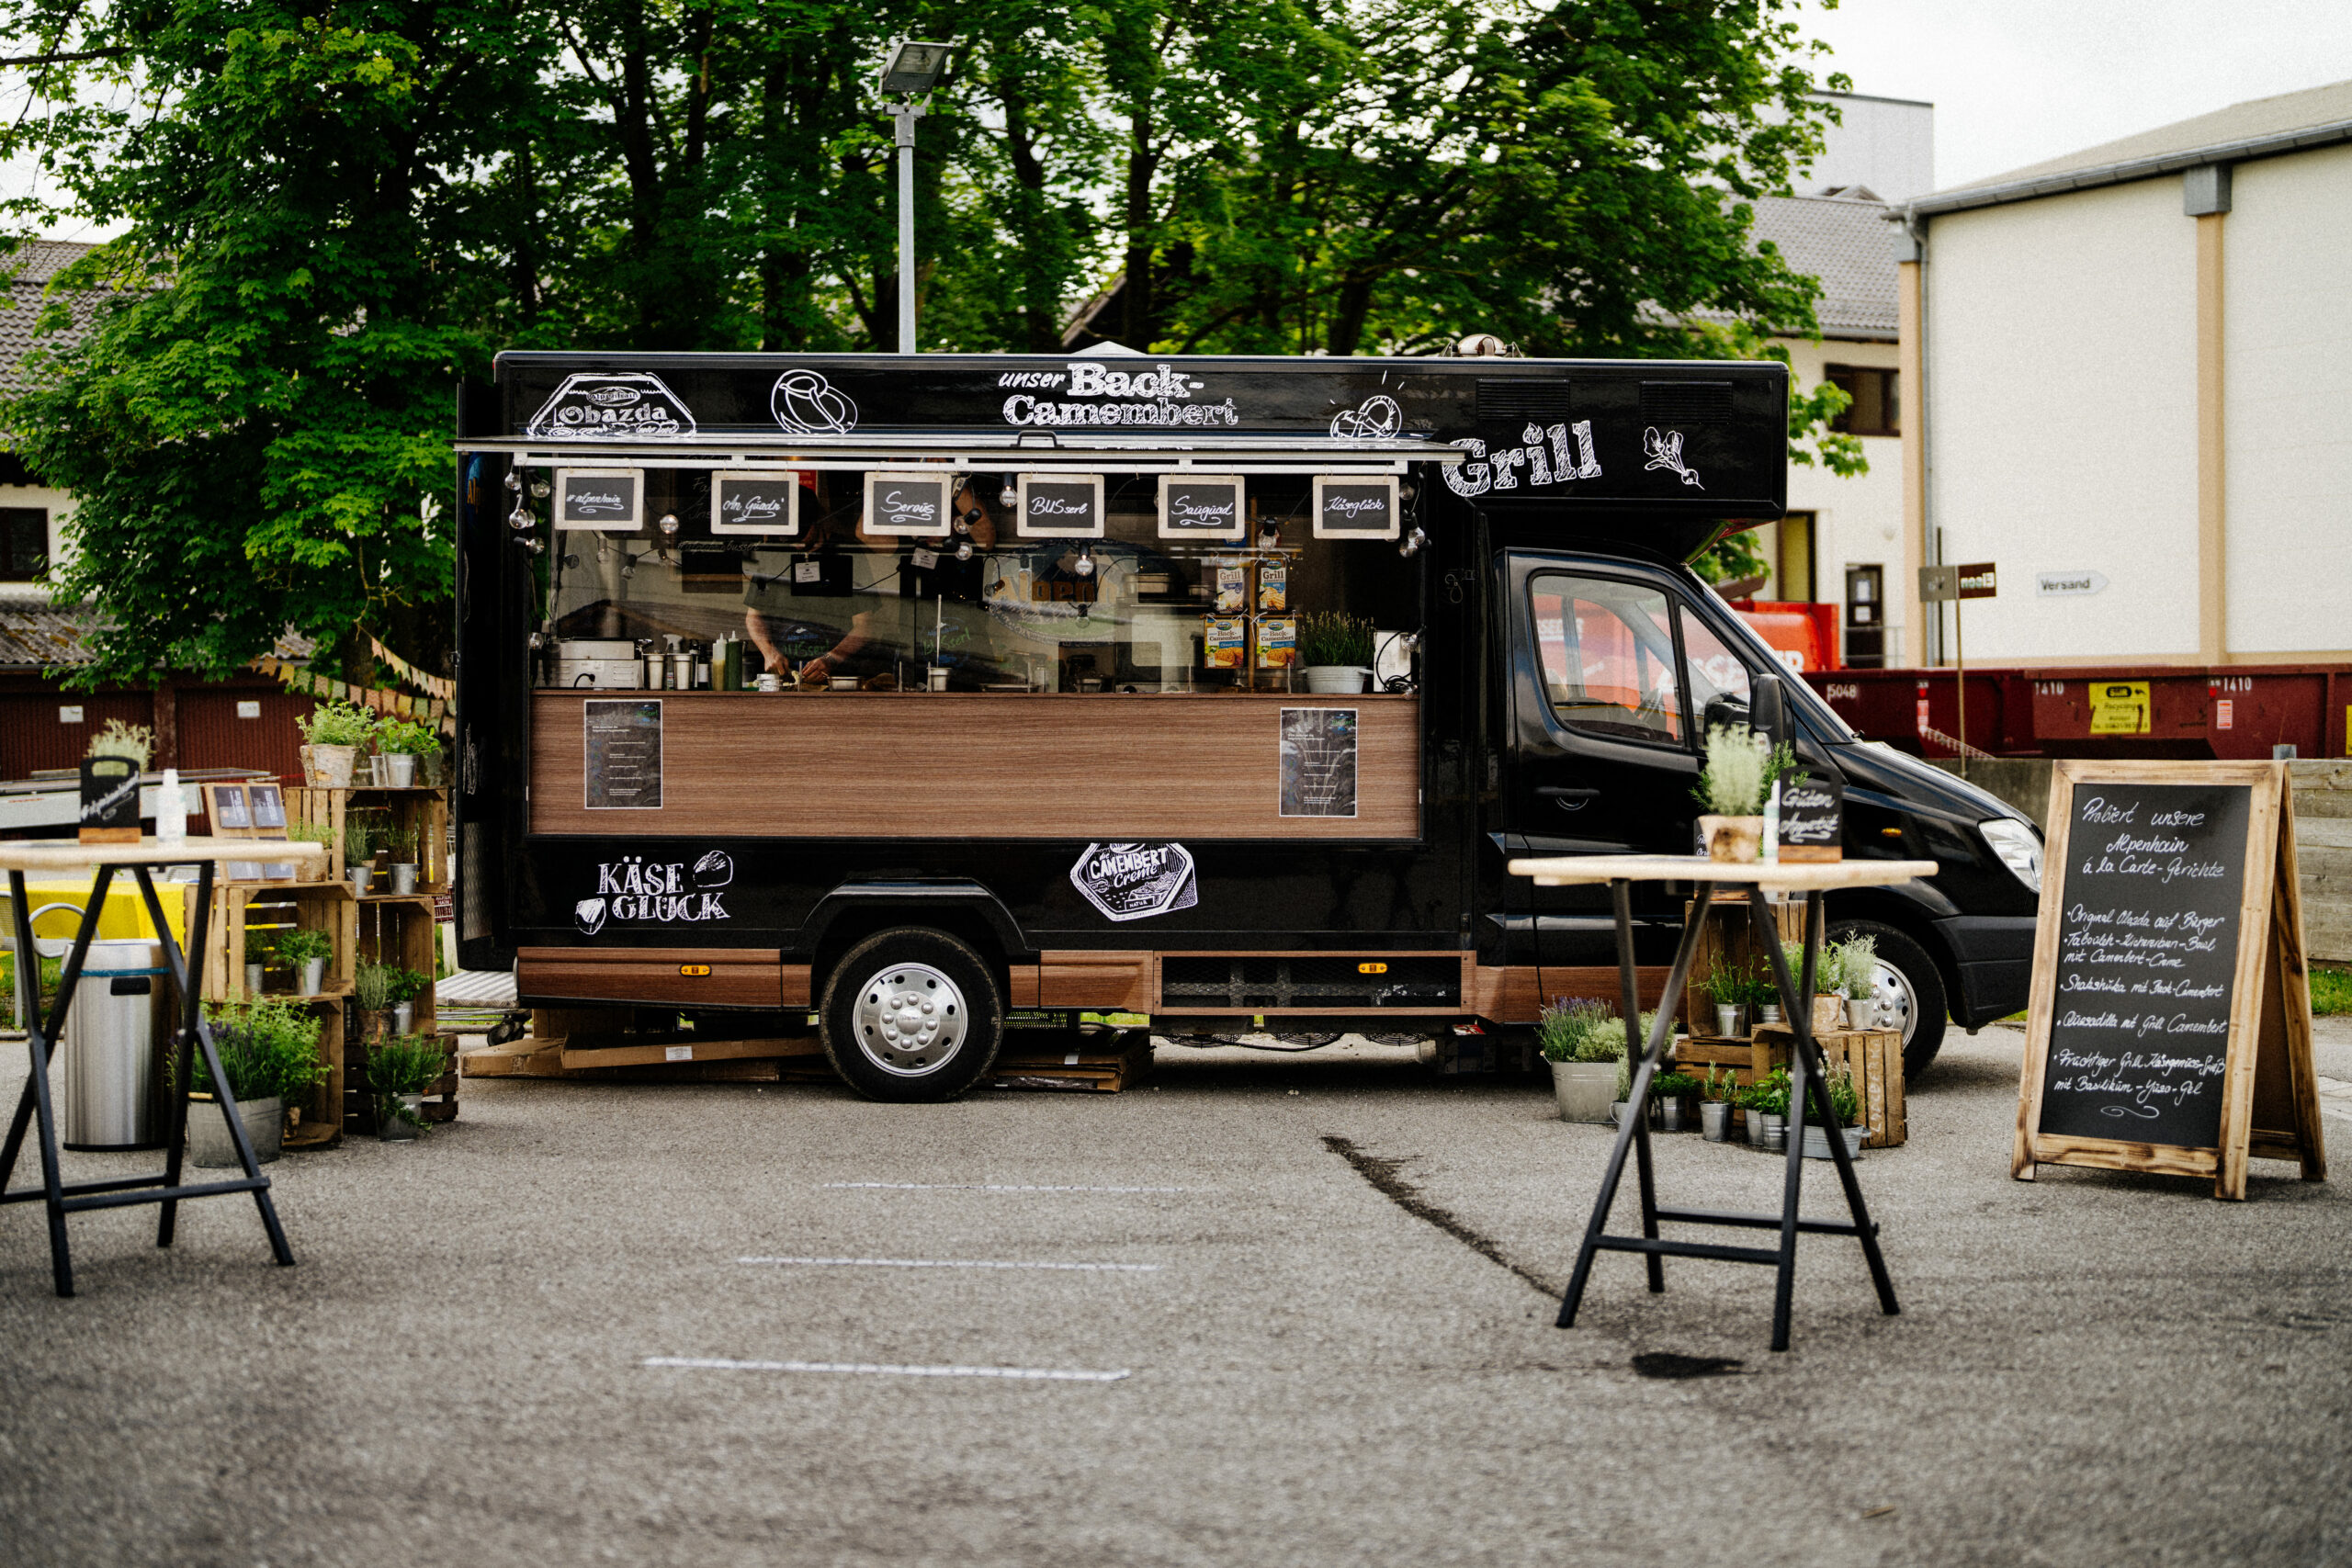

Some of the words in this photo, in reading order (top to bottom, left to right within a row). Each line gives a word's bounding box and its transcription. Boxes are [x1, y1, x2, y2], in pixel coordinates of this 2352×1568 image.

[999, 372, 1066, 388] unser
[1067, 362, 1204, 398] Back-
[558, 403, 668, 424] Obazda
[1002, 394, 1238, 425] Camembert
[1442, 420, 1602, 497] Grill
[1029, 497, 1088, 515] BUSserl
[1219, 571, 1240, 581] Grill
[1262, 570, 1283, 580] Grill
[2041, 578, 2090, 591] Versand
[2034, 682, 2064, 695] 1410
[2223, 676, 2252, 692] 1410
[2082, 796, 2139, 823] Probiert
[2151, 810, 2205, 826] unsere
[2106, 833, 2189, 853] Alpenhain
[1090, 848, 1169, 879] CAMEMBERT
[2096, 856, 2114, 874] la
[596, 855, 684, 896] KÄSE
[1114, 864, 1158, 888] Creme
[612, 892, 731, 921] GLÜCK
[1129, 900, 1148, 908] NATUR
[2064, 949, 2086, 964] mit
[2131, 980, 2149, 993] mit
[2137, 1015, 2165, 1038] Grill
[2166, 1013, 2228, 1034] Camembert
[2114, 1052, 2143, 1077] Grill
[2053, 1077, 2072, 1090] mit
